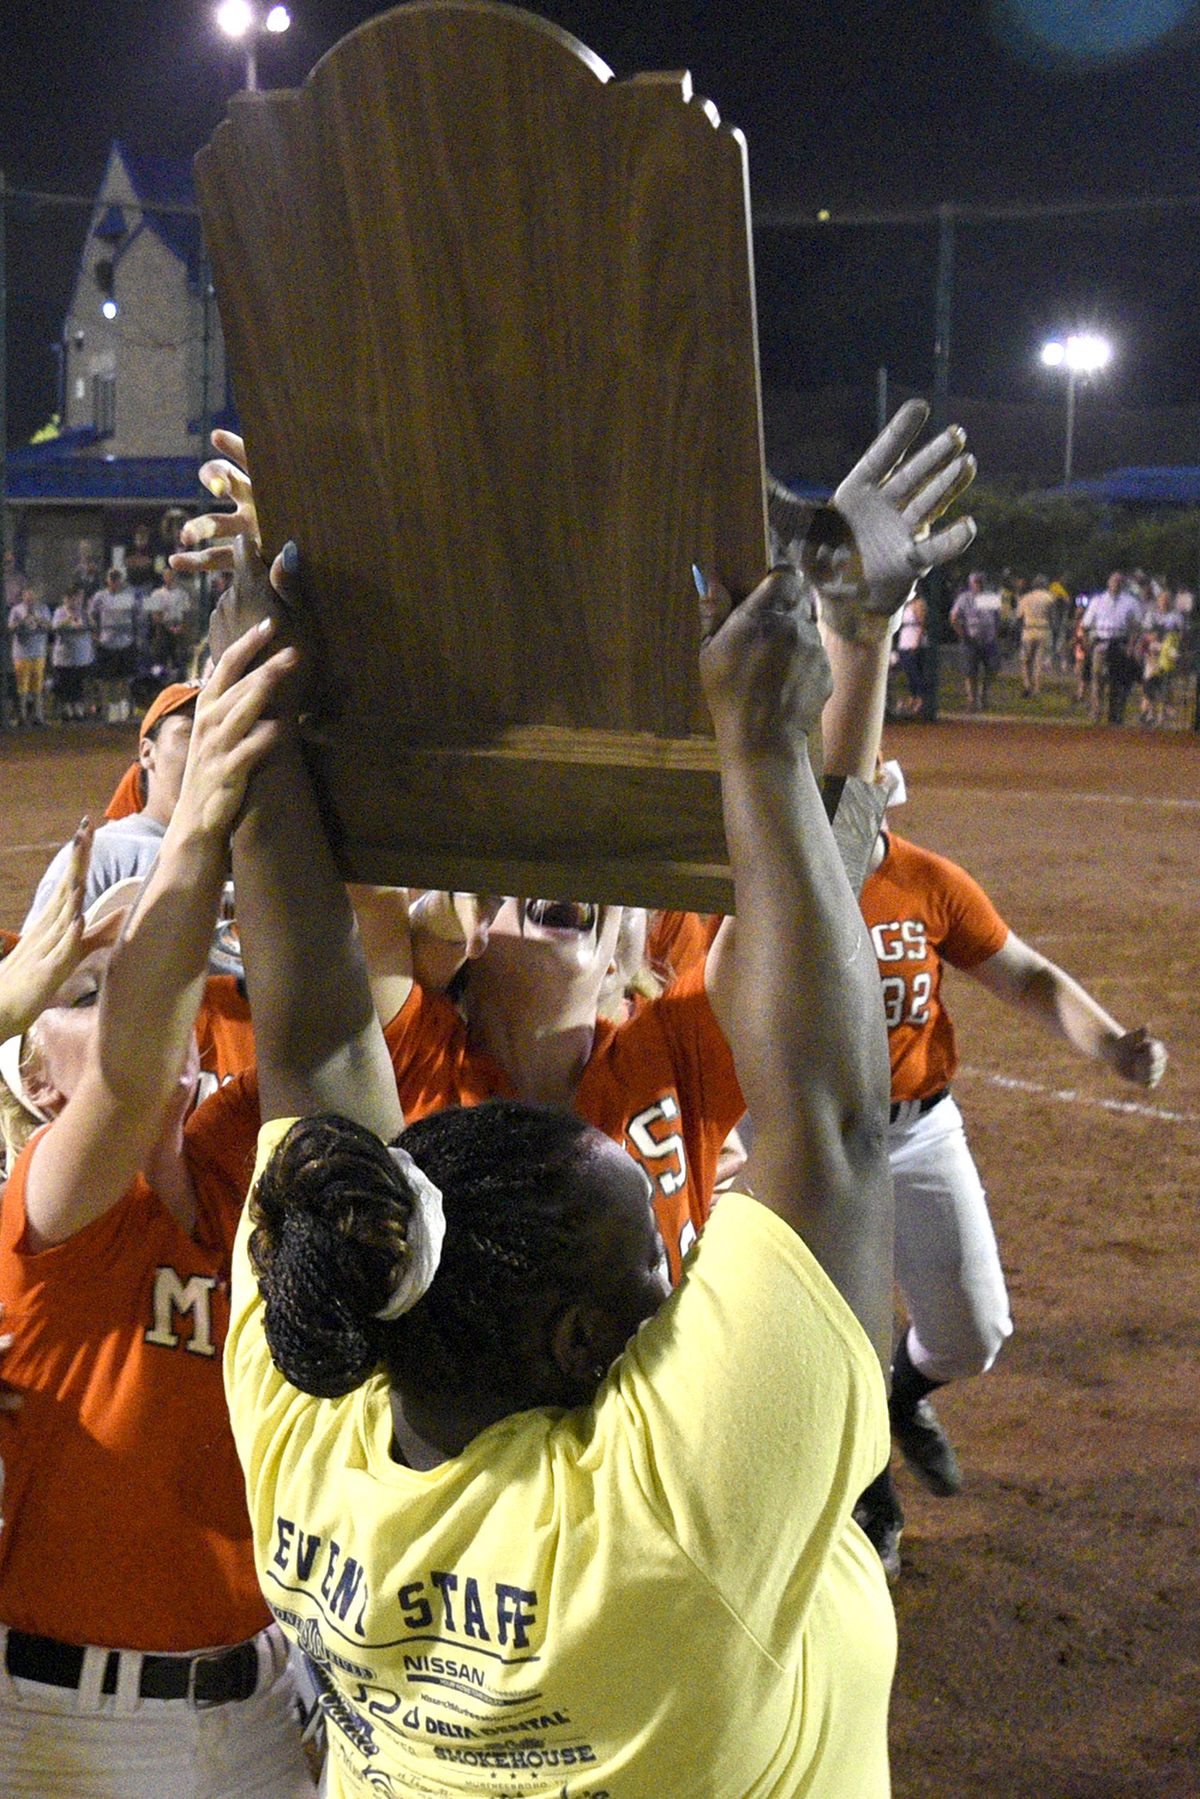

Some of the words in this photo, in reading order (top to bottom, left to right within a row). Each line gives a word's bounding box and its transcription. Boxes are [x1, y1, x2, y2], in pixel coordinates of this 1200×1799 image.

[397, 1570, 538, 1650] STAFF
[402, 1655, 485, 1688] NISSAN
[425, 1716, 480, 1739] DELTA
[434, 1744, 597, 1769] SMOKEHOUSE
